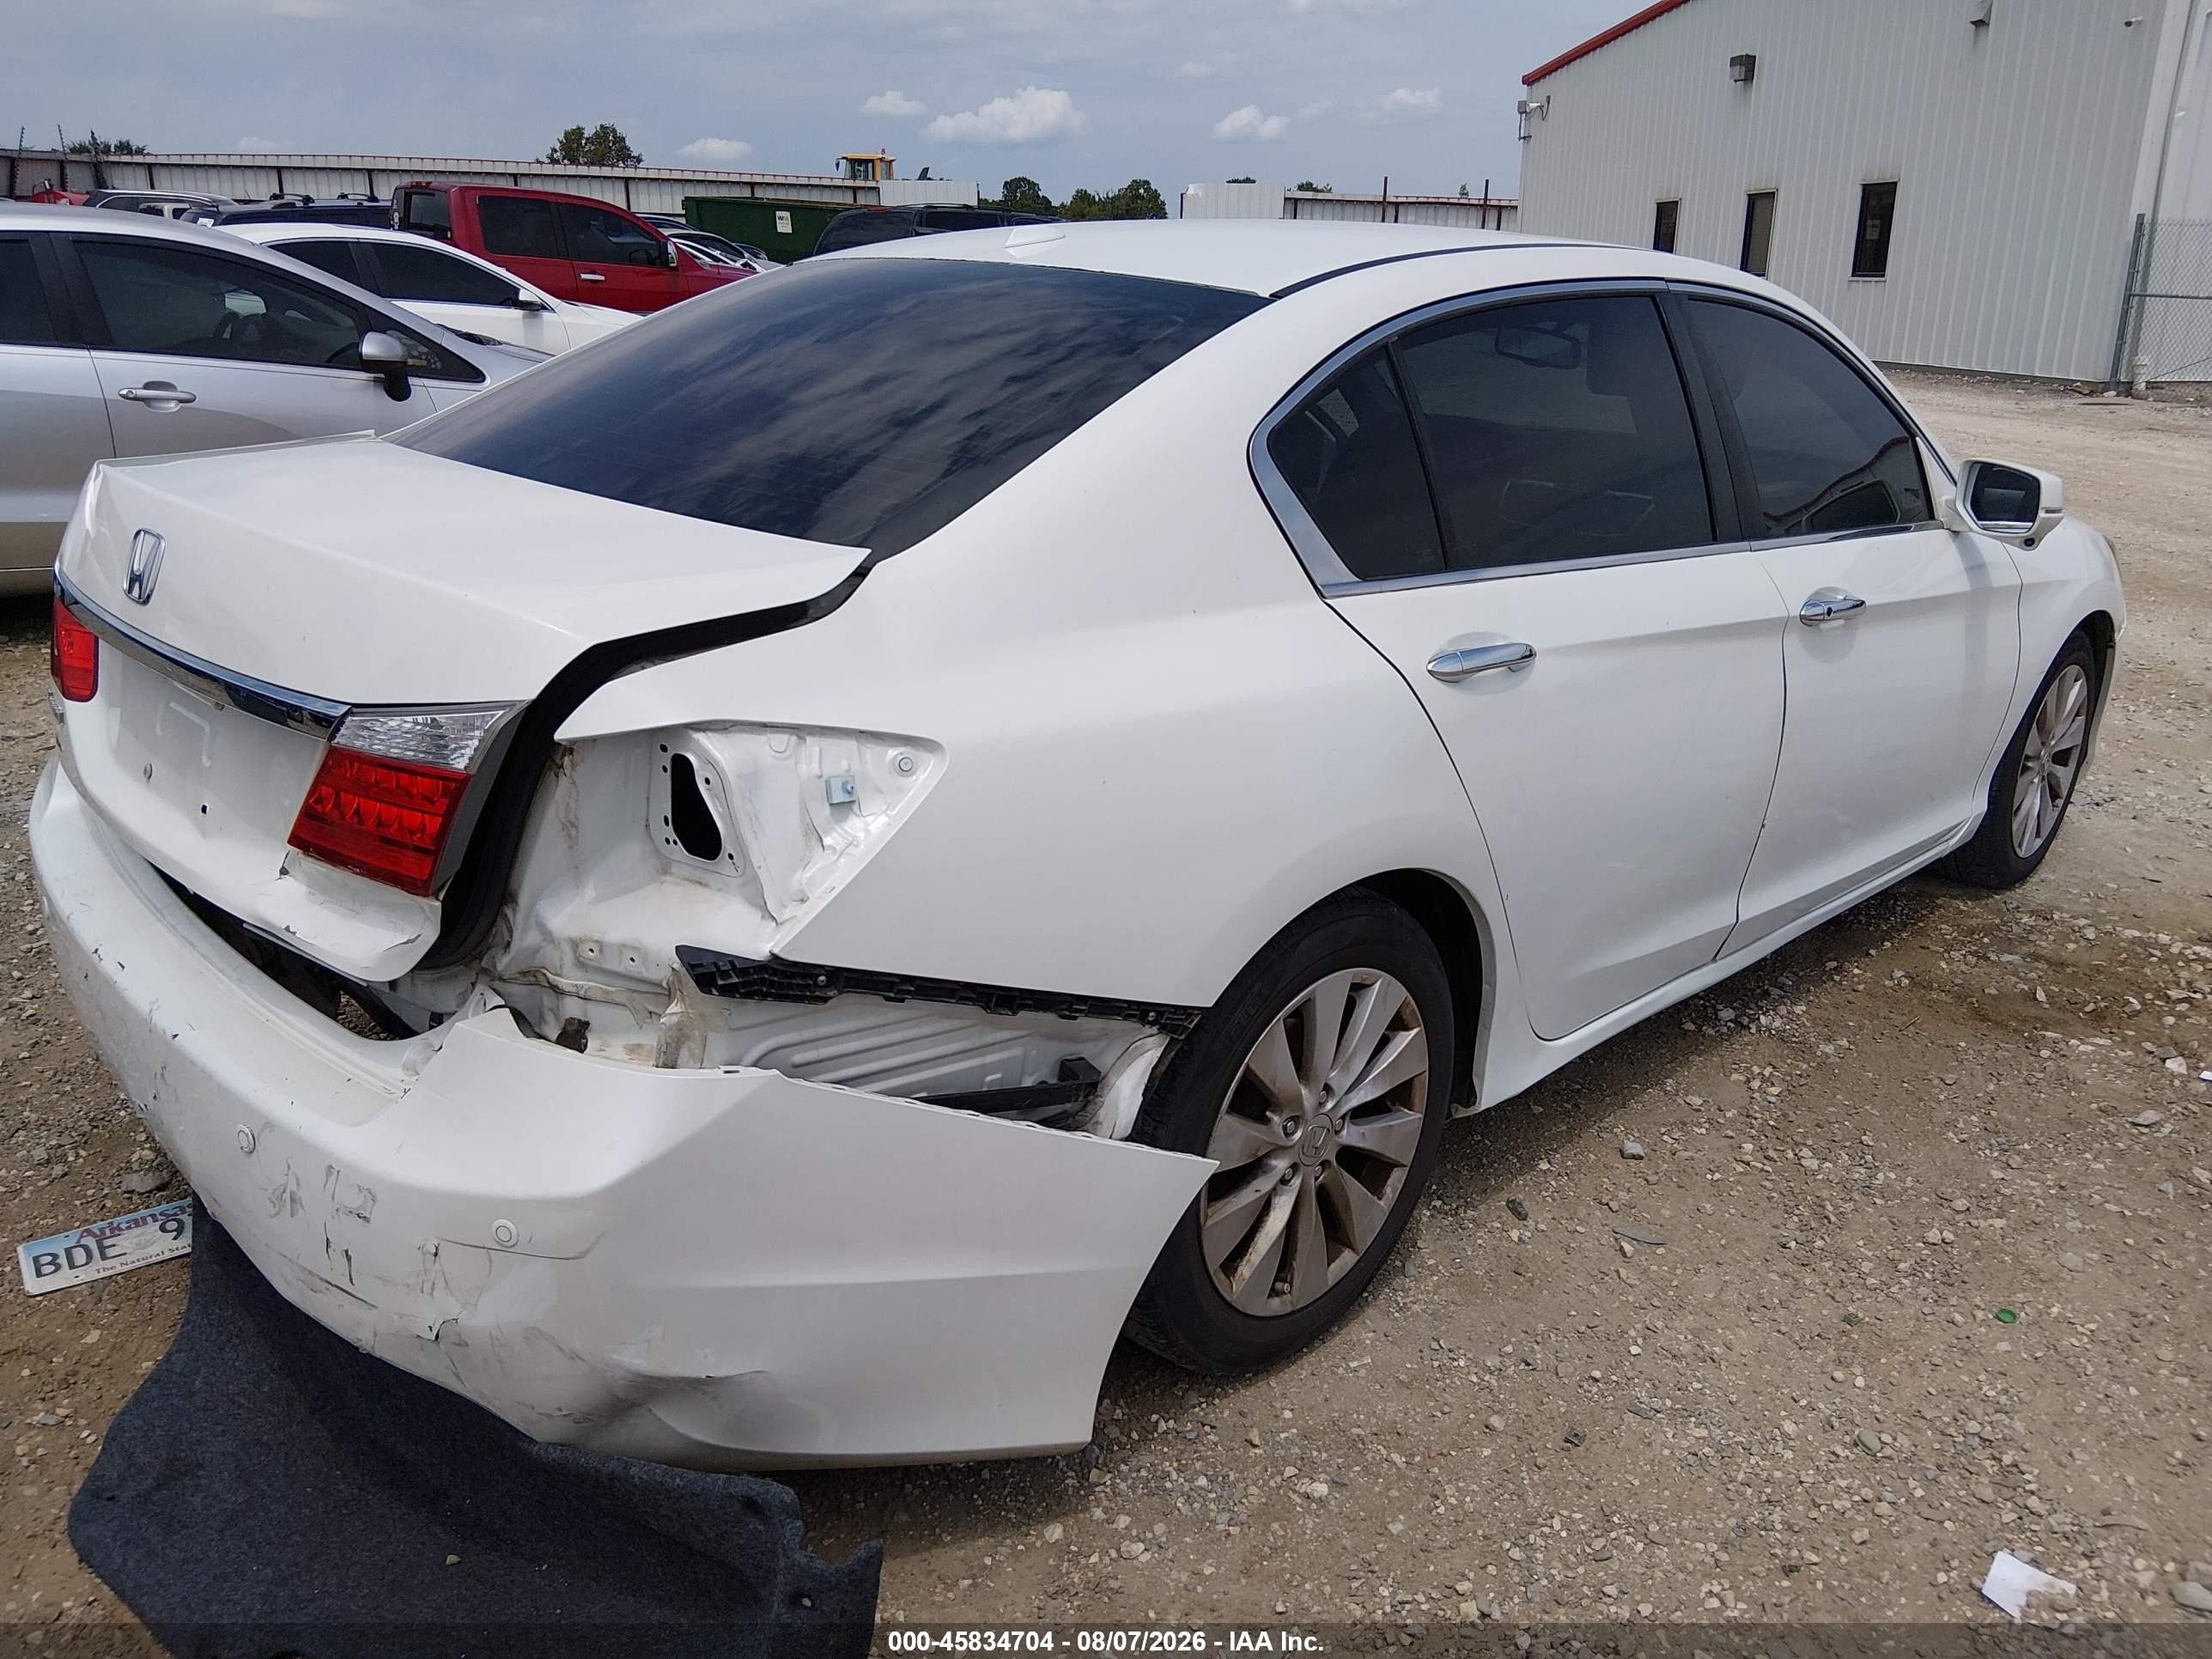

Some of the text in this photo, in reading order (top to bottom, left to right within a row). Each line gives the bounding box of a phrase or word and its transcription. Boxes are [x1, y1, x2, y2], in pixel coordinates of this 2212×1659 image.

[32, 1218, 185, 1279] BDE 9
[96, 1264, 117, 1274] The
[120, 1250, 165, 1268] Natural
